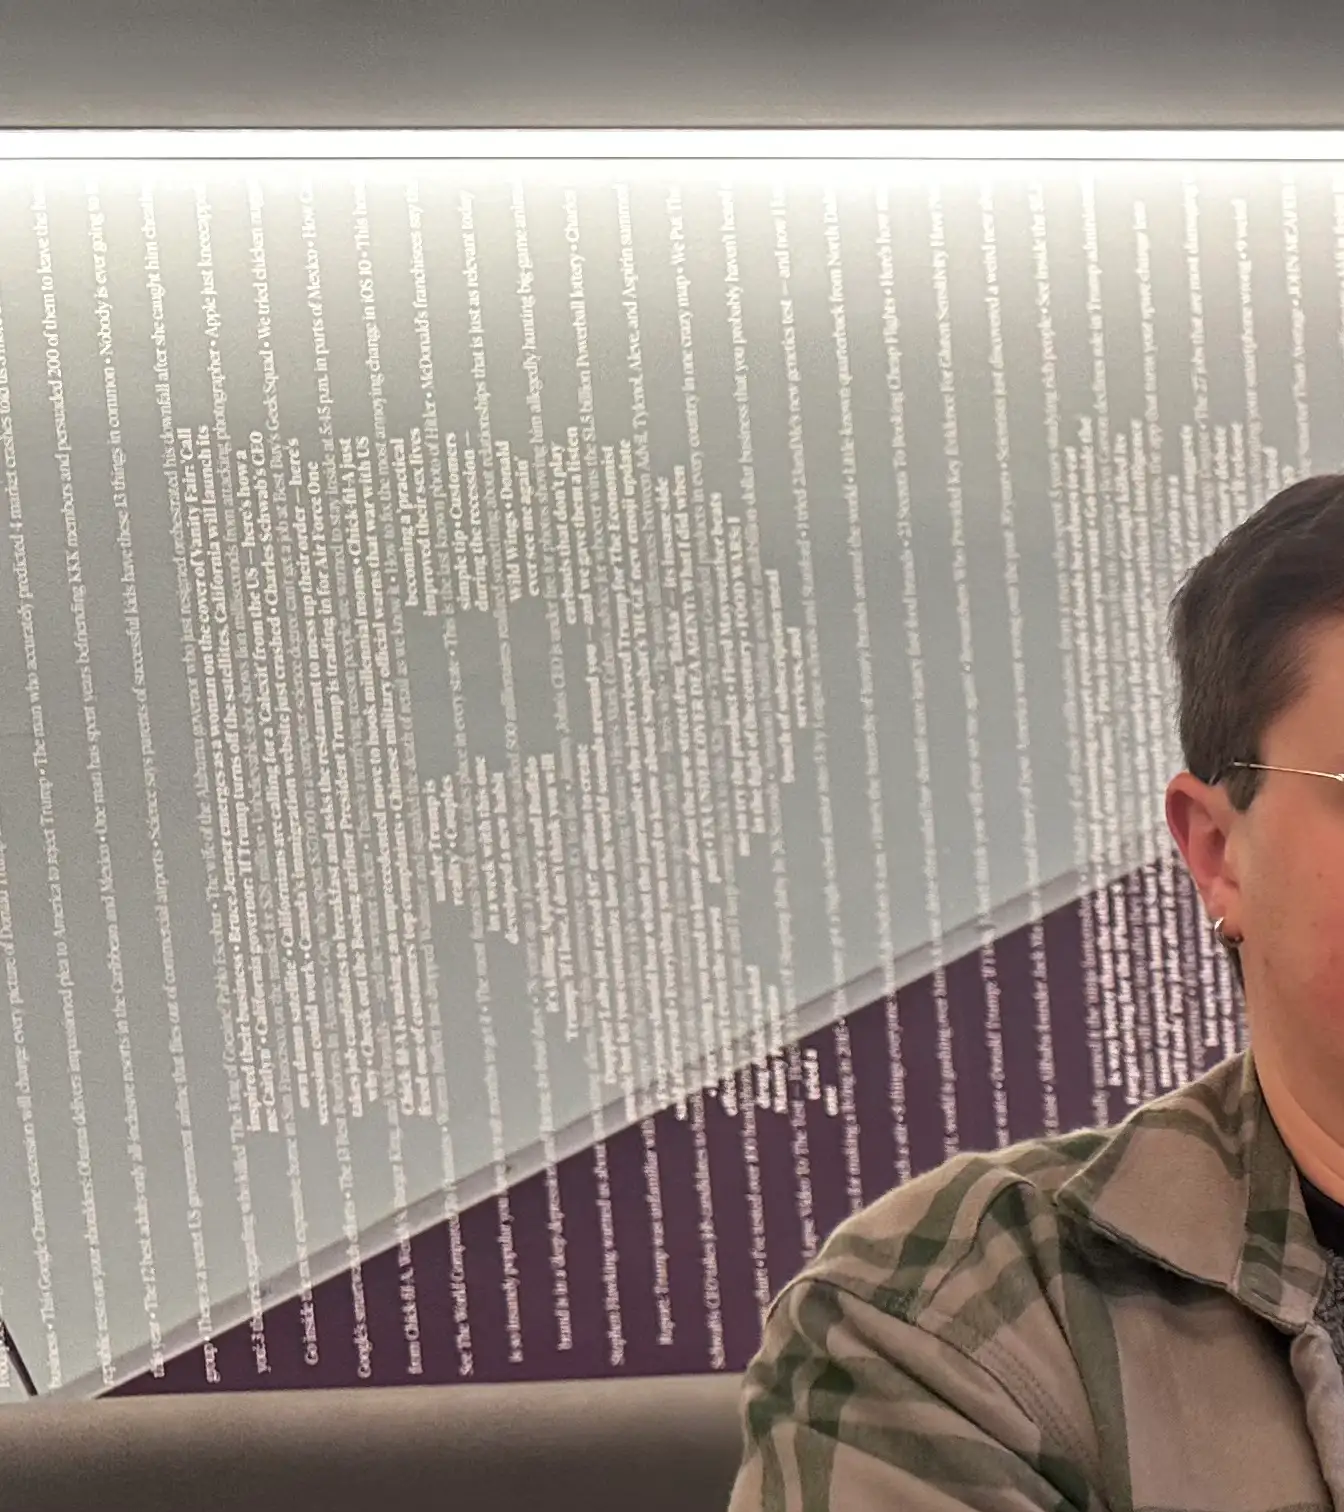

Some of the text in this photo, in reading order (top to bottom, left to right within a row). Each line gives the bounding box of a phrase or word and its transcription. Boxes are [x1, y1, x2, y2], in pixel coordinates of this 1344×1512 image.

[37, 276, 52, 290] to
[253, 282, 269, 314] tried
[39, 293, 56, 329] them
[256, 316, 271, 337] We
[43, 332, 58, 346] of
[142, 242, 177, 466] his downfall after she caught him
[45, 348, 61, 376] 200
[259, 349, 279, 392] Squad
[48, 380, 71, 450] persuaded
[263, 394, 279, 430] Geek
[194, 426, 209, 446] its
[248, 431, 265, 466] CEO
[55, 453, 71, 480] and
[196, 448, 215, 504] launch
[58, 482, 78, 546] members
[92, 254, 158, 785] says parents of successful kids have these 13 things in common Nobody is ever
[185, 504, 206, 556] Vanity
[202, 506, 219, 538] will
[65, 550, 82, 582] KKK
[190, 560, 205, 576] of
[206, 540, 227, 622] California
[259, 543, 278, 606] Charles
[195, 579, 210, 622] cover
[69, 584, 93, 663] befriending
[196, 624, 213, 651] the
[202, 652, 215, 674] on
[266, 616, 285, 679] crashed
[204, 676, 221, 736] woman
[272, 682, 291, 711] just
[81, 706, 101, 742] spent
[222, 702, 238, 728] the
[85, 744, 100, 768] has
[211, 739, 222, 748] a
[212, 750, 224, 766] as
[225, 732, 240, 753] off
[275, 713, 294, 773] website
[227, 754, 244, 795] turns
